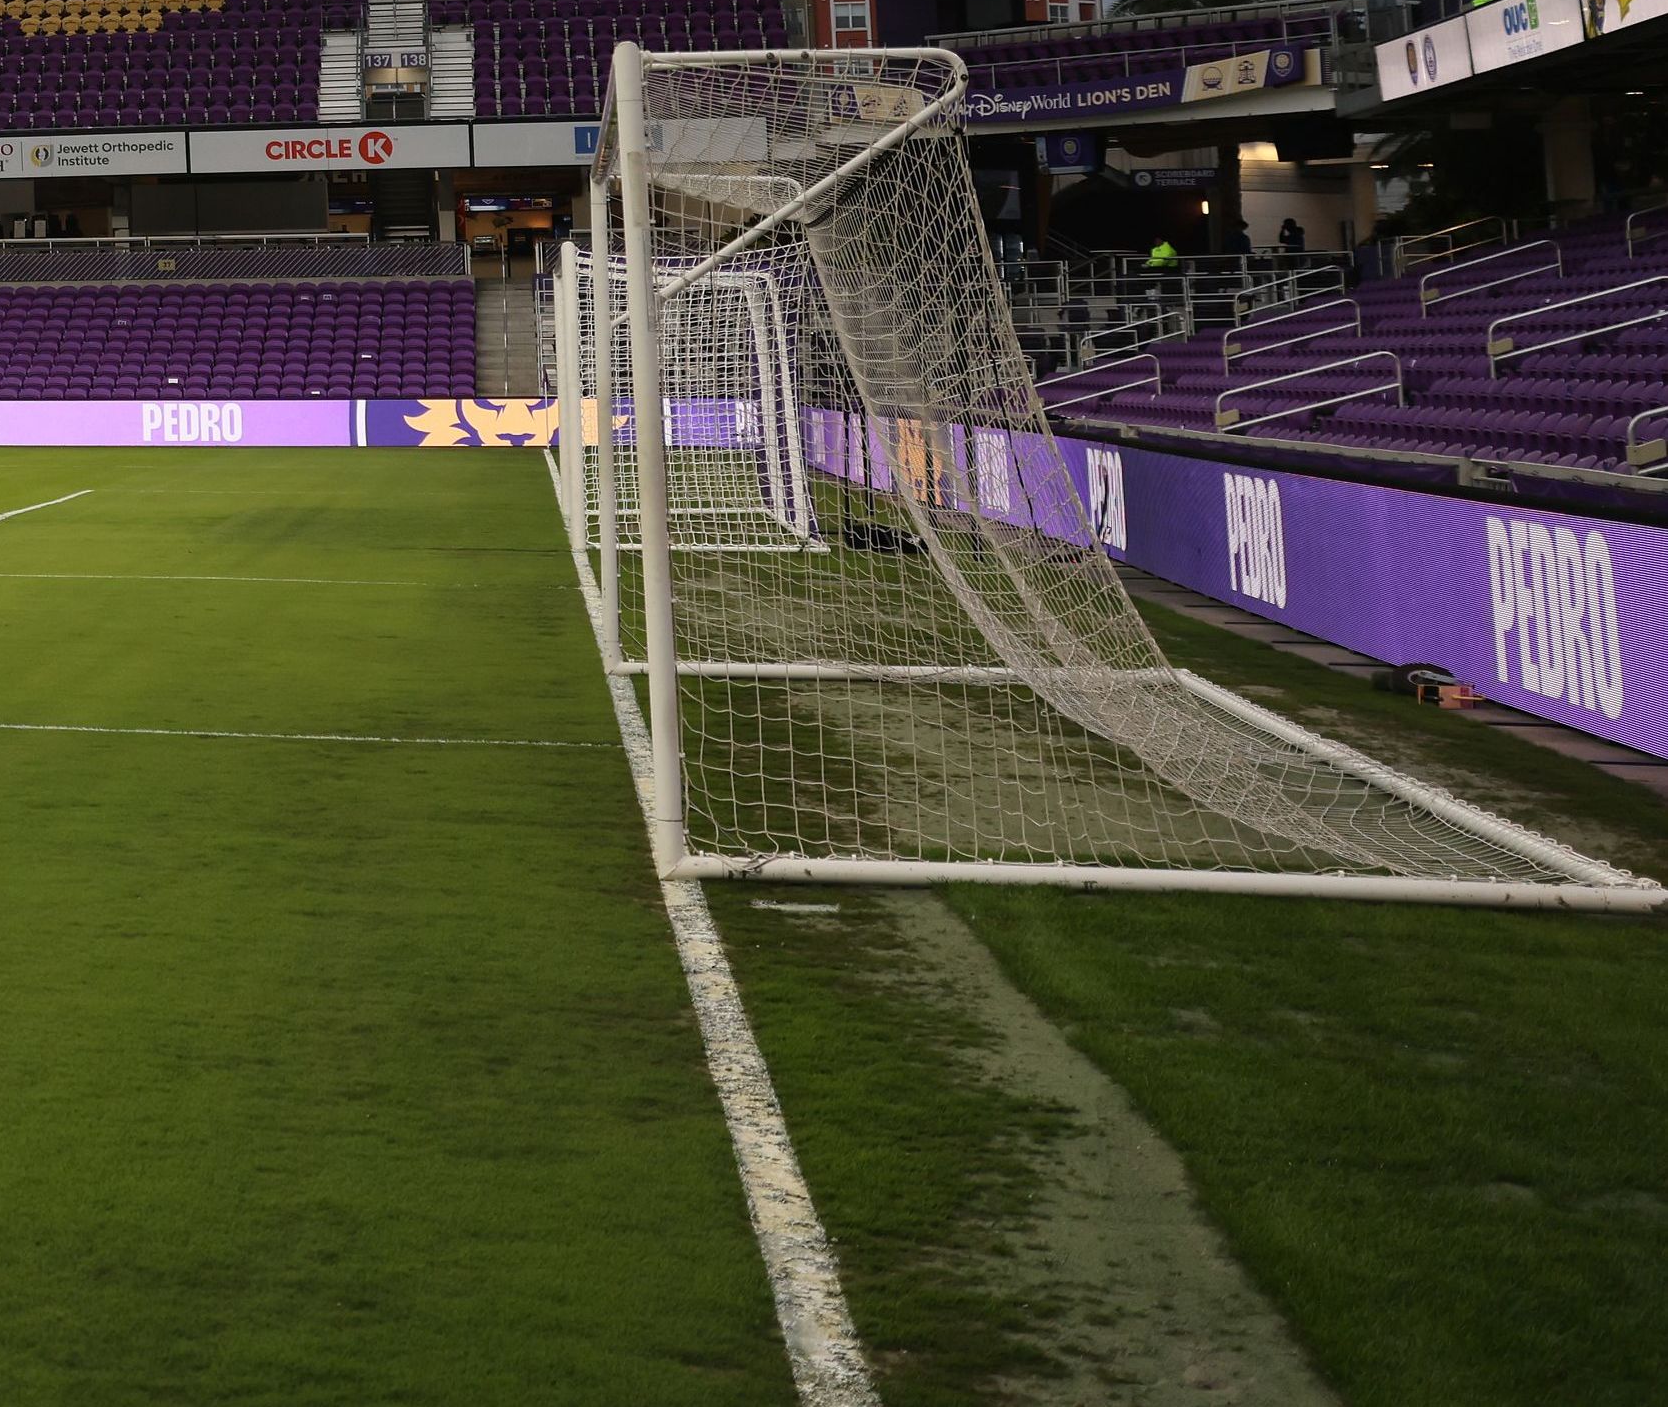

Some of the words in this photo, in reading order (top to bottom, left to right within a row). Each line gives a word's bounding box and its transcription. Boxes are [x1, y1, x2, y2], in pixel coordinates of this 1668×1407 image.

[1503, 2, 1528, 36] OUC
[365, 54, 392, 67] 137
[402, 54, 426, 67] 138
[1030, 92, 1072, 111] World
[1076, 87, 1132, 108] LION'S
[1135, 81, 1171, 100] DEN
[57, 143, 99, 156] Jewett
[101, 140, 175, 156] Orthopedic
[265, 139, 352, 160] CIRCLE
[57, 155, 110, 167] Institute
[1154, 169, 1216, 179] SCOREBOARD
[1155, 178, 1197, 186] TERRACE
[142, 401, 243, 443] PEDRO
[1086, 448, 1128, 553] PEDRO
[1224, 473, 1287, 610] PEDRO
[1486, 515, 1625, 721] PEDRO
